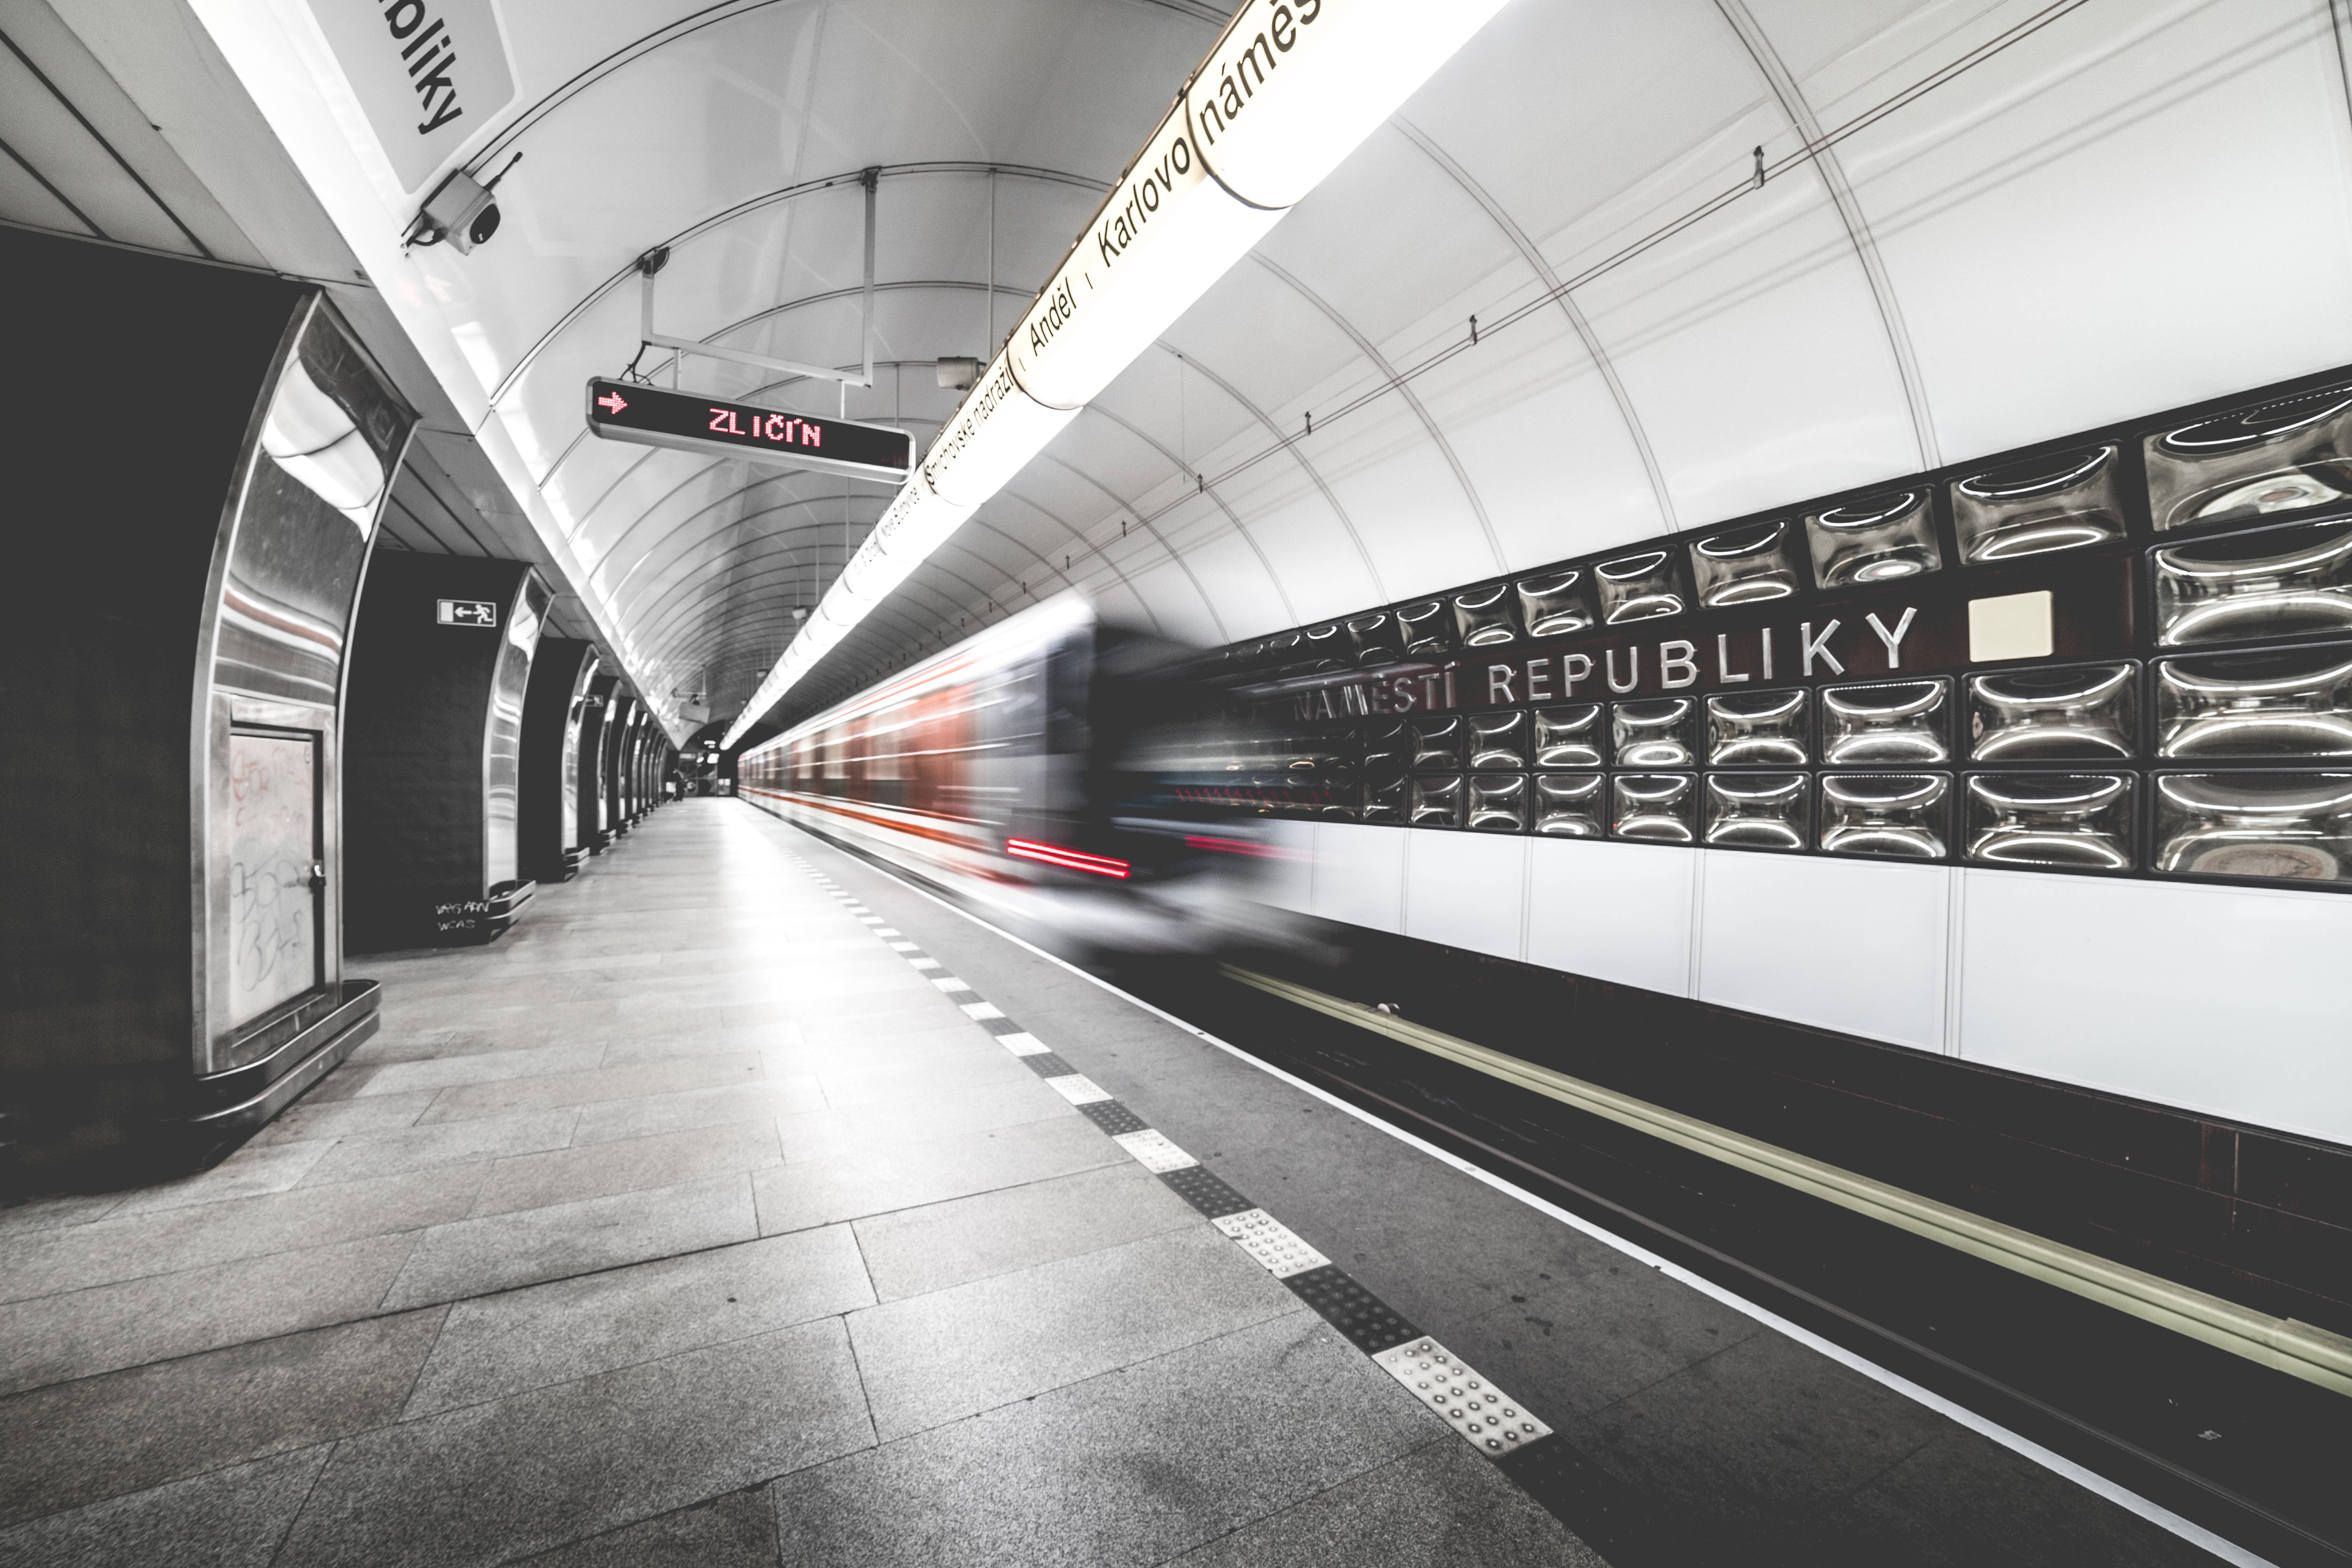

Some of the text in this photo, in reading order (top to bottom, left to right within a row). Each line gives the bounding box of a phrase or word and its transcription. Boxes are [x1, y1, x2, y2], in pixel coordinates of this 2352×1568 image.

[379, 0, 462, 135] bliky
[973, 358, 1015, 427] nádraží
[1031, 276, 1076, 357] Anděl
[1098, 137, 1190, 268] Karlovo
[709, 408, 821, 447] ZLIČÍN
[1488, 607, 1917, 704] REPUBLIKY
